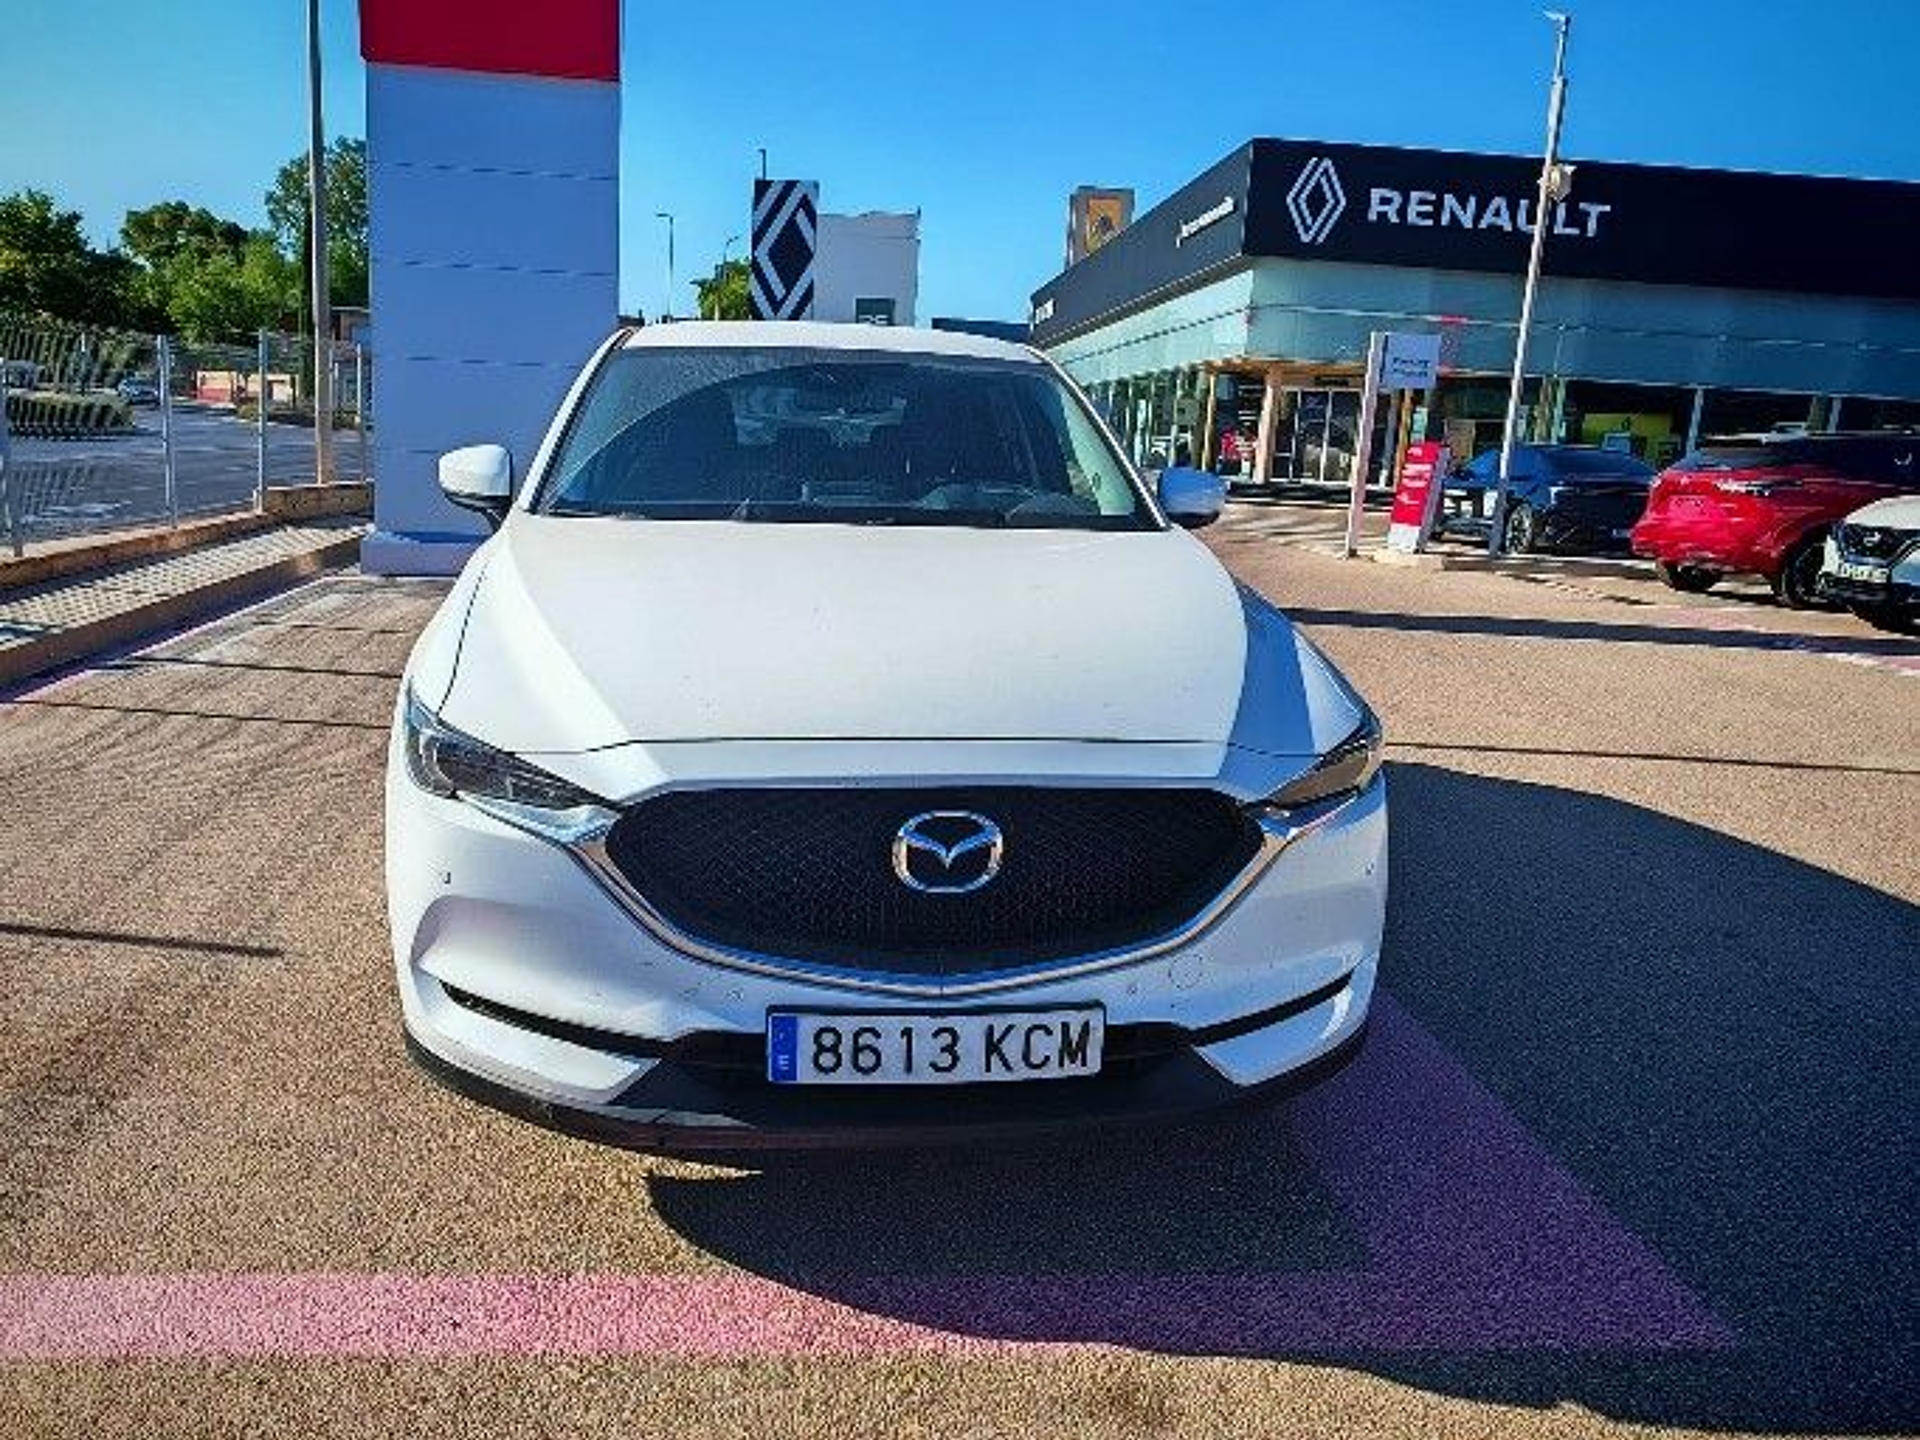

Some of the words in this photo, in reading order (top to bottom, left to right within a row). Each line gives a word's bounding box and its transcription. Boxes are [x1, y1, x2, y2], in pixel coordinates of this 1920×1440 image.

[1367, 187, 1612, 237] RENAULT
[812, 1026, 960, 1075] 8613
[984, 1019, 1090, 1073] KCM
